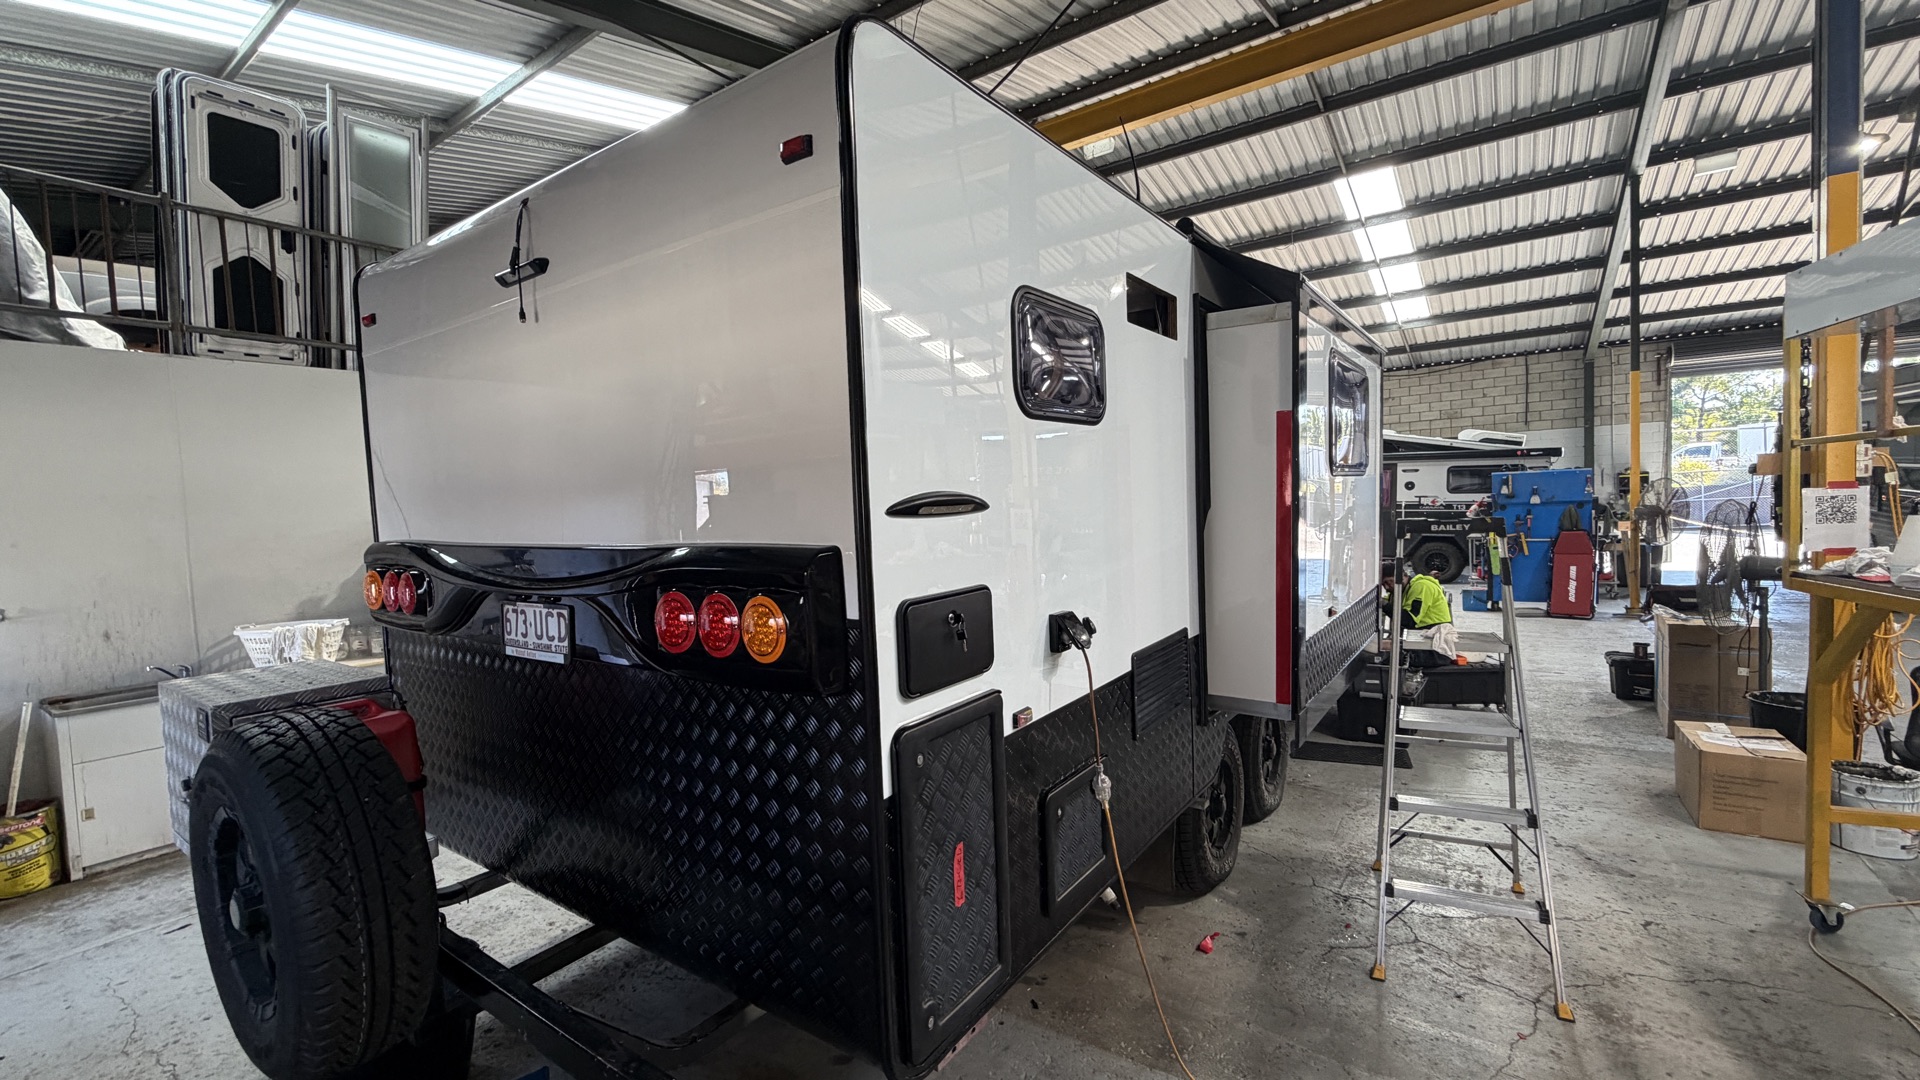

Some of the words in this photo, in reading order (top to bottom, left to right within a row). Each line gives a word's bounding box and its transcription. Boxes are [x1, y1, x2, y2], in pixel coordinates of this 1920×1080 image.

[1430, 523, 1471, 531] BAILEY
[1567, 579, 1577, 603] Repco
[532, 641, 553, 652] SUNSHINE
[554, 644, 568, 653] STATE
